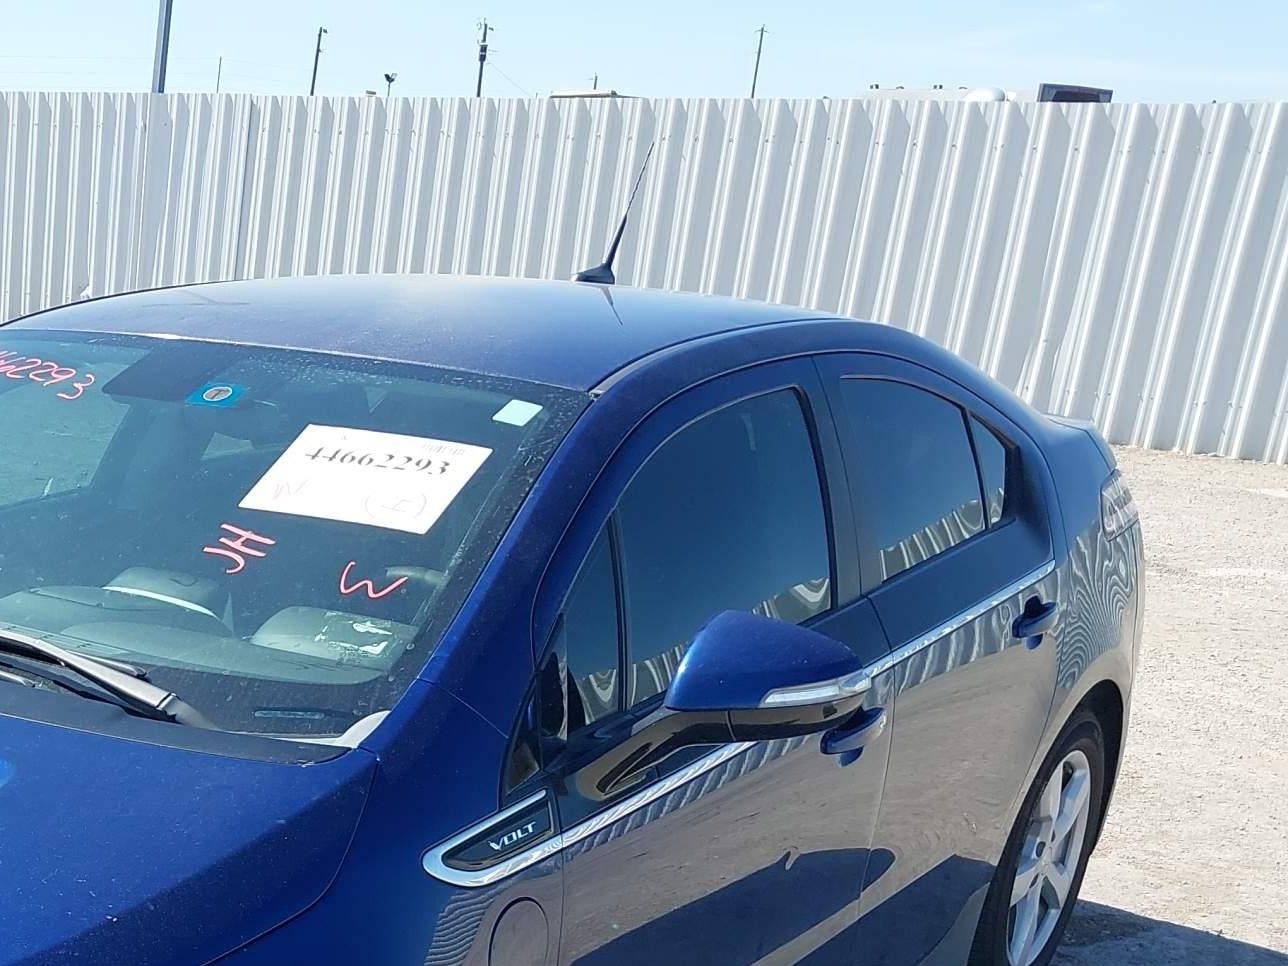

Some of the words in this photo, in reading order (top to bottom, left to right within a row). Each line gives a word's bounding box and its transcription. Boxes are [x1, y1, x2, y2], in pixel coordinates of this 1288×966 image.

[305, 446, 451, 475] 44662293
[203, 523, 276, 574] JH
[488, 821, 536, 851] VOLT
